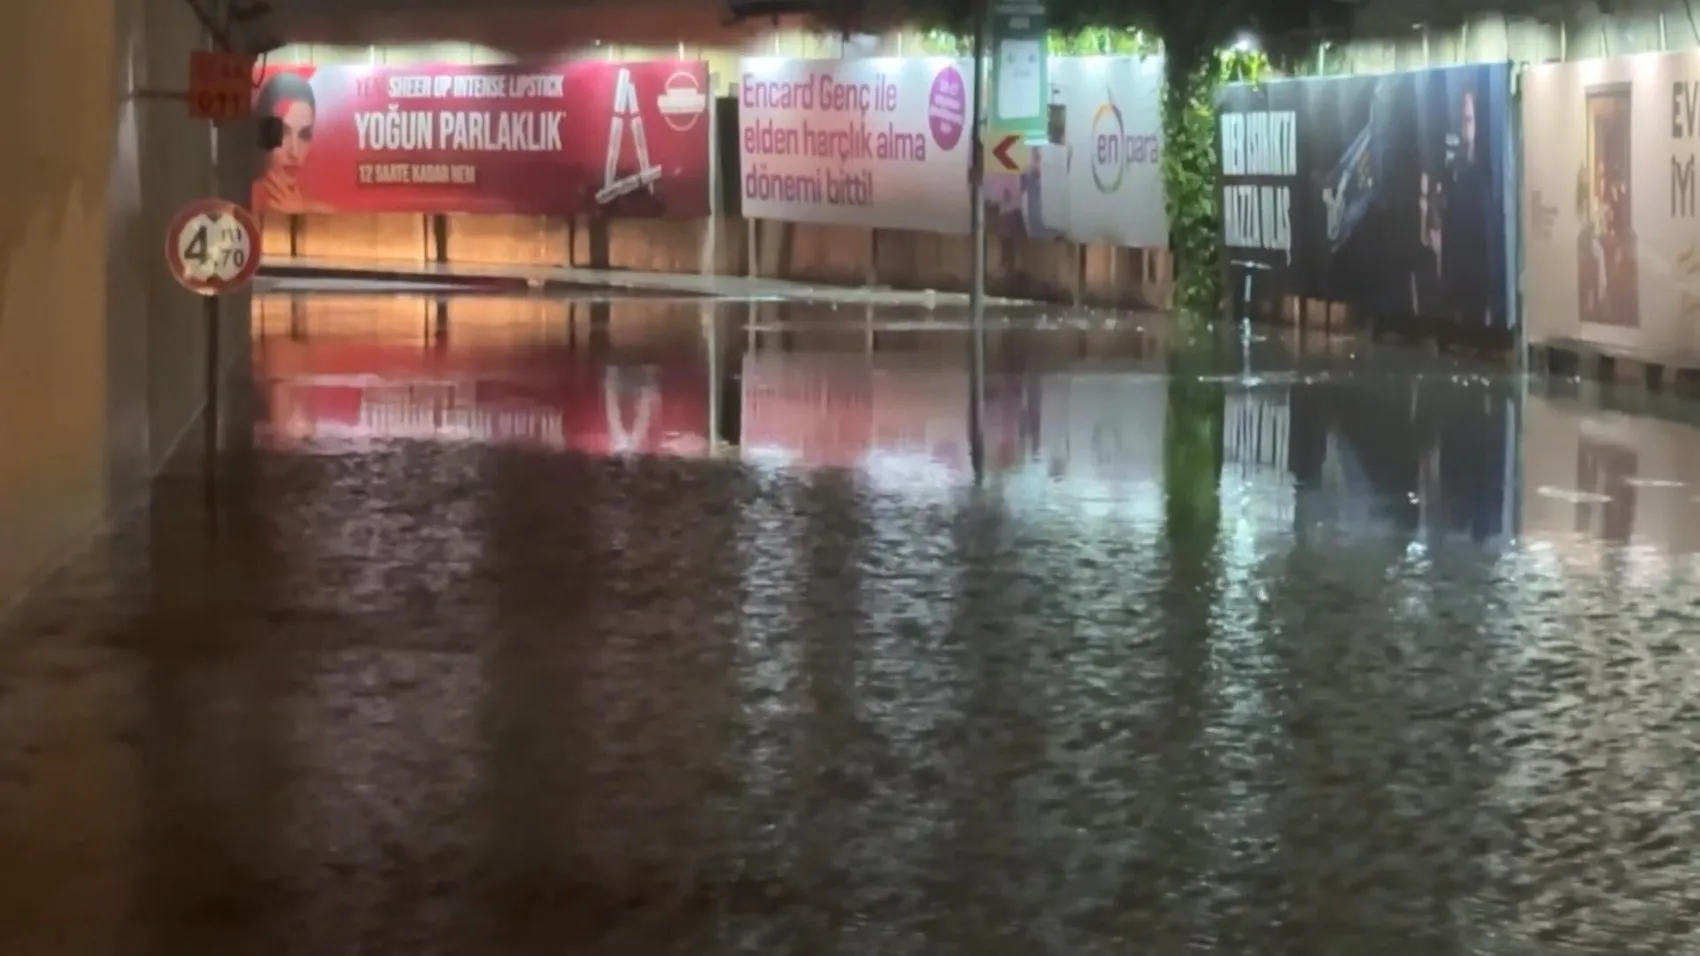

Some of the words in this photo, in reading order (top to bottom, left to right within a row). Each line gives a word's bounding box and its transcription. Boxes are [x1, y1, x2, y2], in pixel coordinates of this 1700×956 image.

[742, 73, 815, 110] Encard
[819, 74, 871, 117] Genç
[875, 74, 897, 112] ile
[1671, 80, 1700, 139] EV
[355, 104, 433, 150] YOĞUN
[440, 111, 563, 151] PARLAKLIK
[743, 118, 799, 155] elden
[804, 119, 873, 163] harçlık
[876, 122, 926, 162] alma
[359, 164, 373, 183] 12
[745, 164, 822, 204] dönemi
[183, 224, 209, 265] 4
